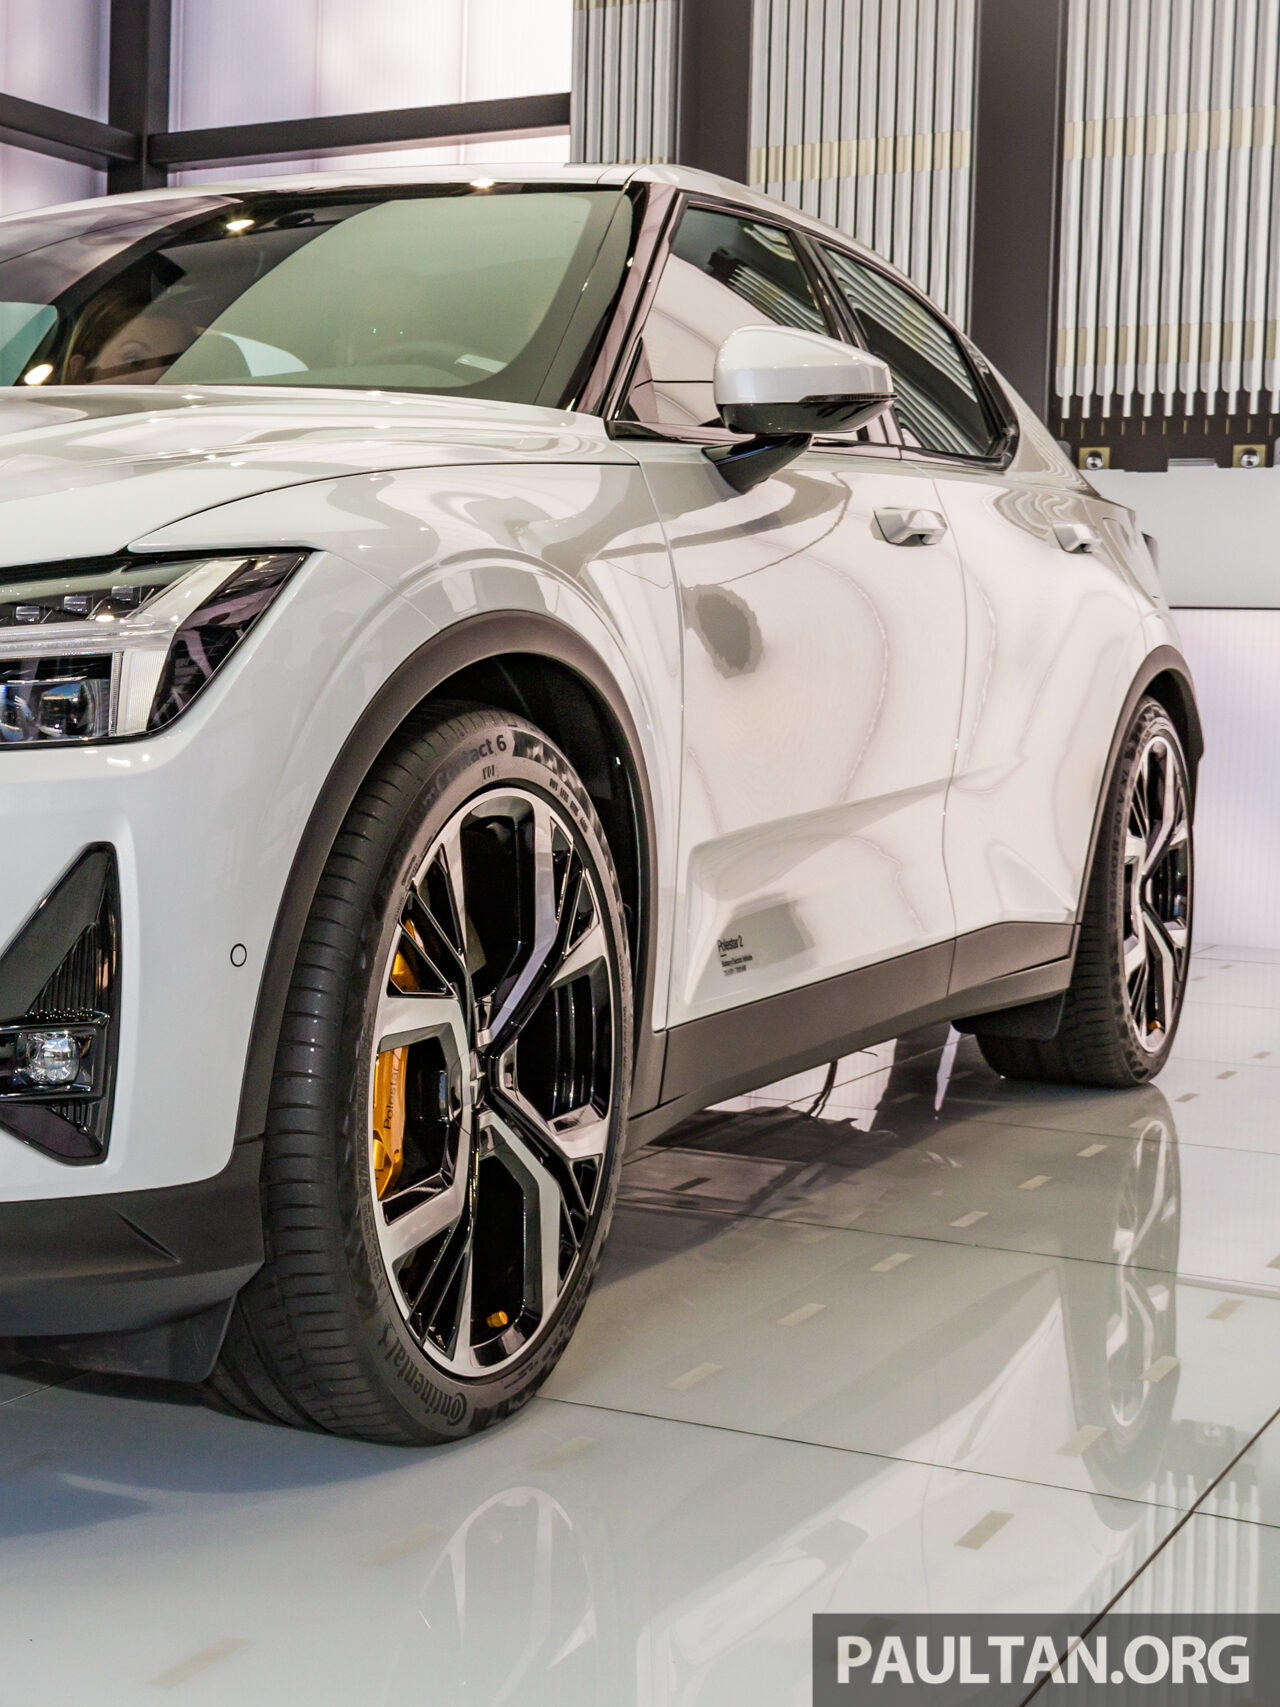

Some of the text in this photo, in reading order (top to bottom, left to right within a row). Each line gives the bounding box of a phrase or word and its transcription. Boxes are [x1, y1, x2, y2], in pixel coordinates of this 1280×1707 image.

[496, 734, 507, 752] 6
[1113, 811, 1122, 836] 20
[383, 1067, 400, 1130] Polestar
[384, 1336, 467, 1426] Continental
